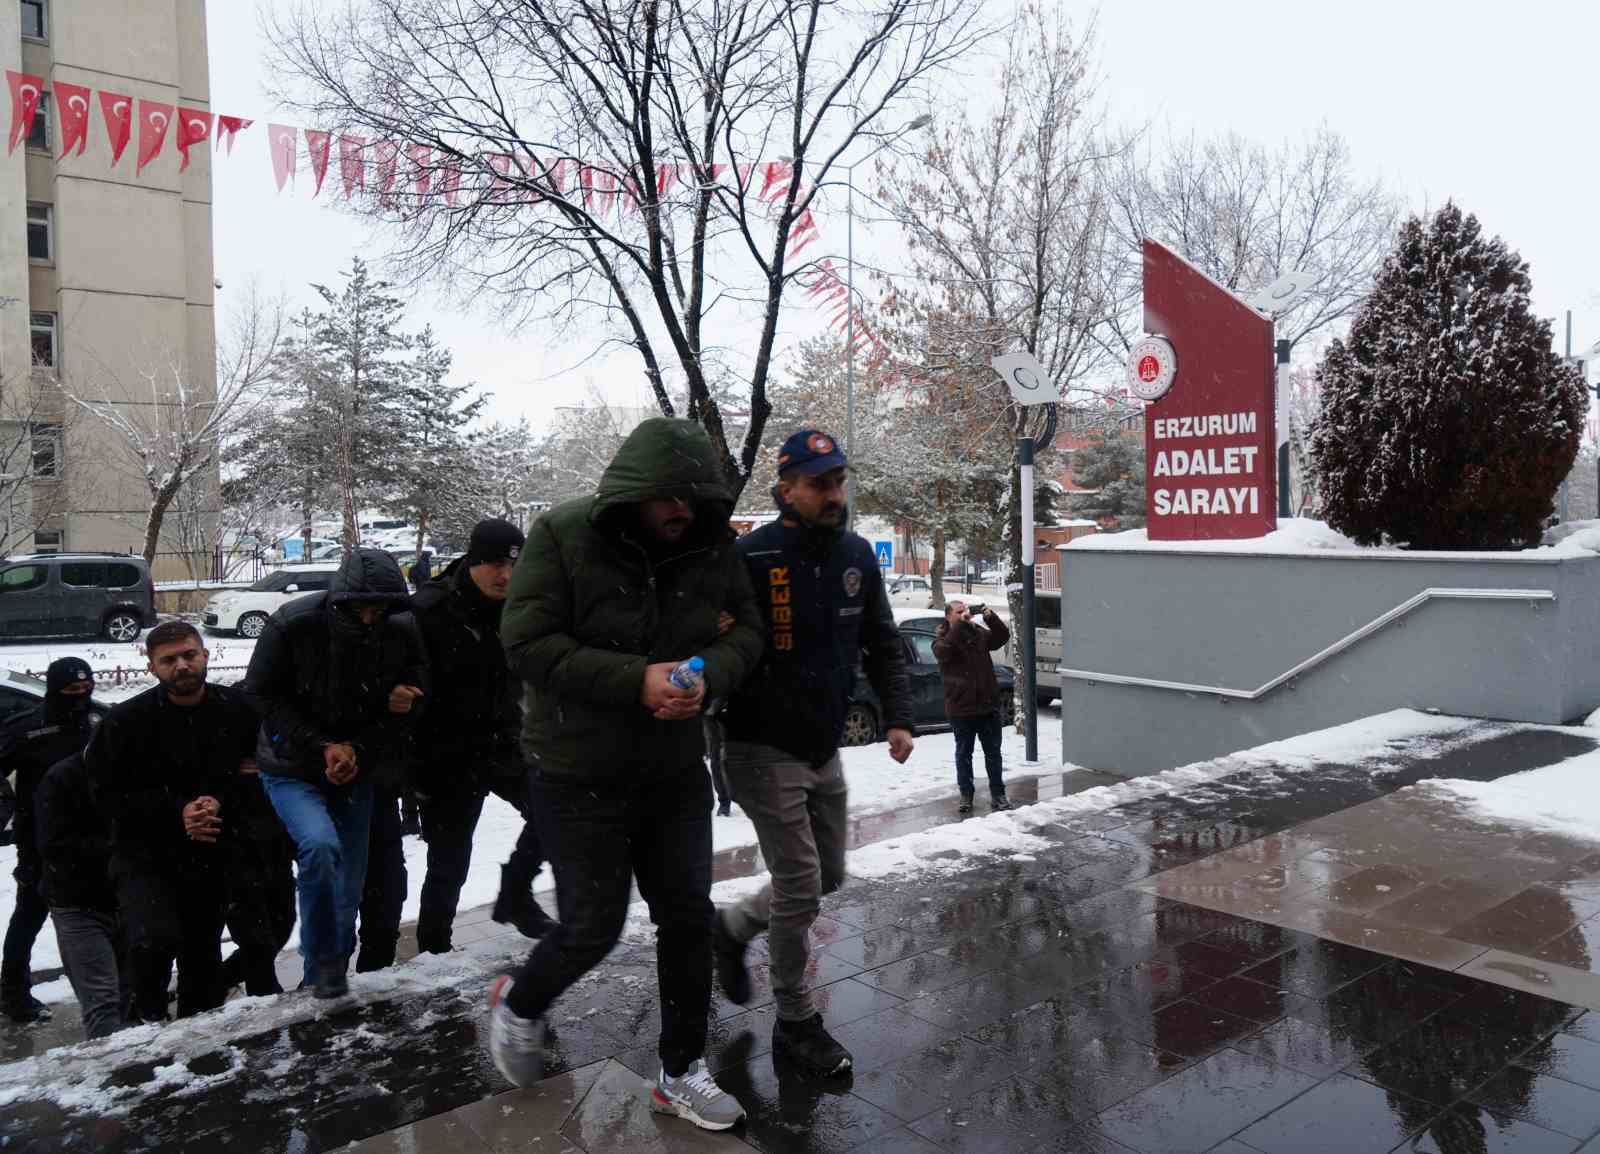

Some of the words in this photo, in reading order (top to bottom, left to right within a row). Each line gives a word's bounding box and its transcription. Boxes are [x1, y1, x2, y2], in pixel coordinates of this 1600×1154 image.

[1154, 412, 1256, 439] ERZURUM
[1153, 446, 1258, 477] ADALET
[1153, 487, 1258, 516] SARAYI
